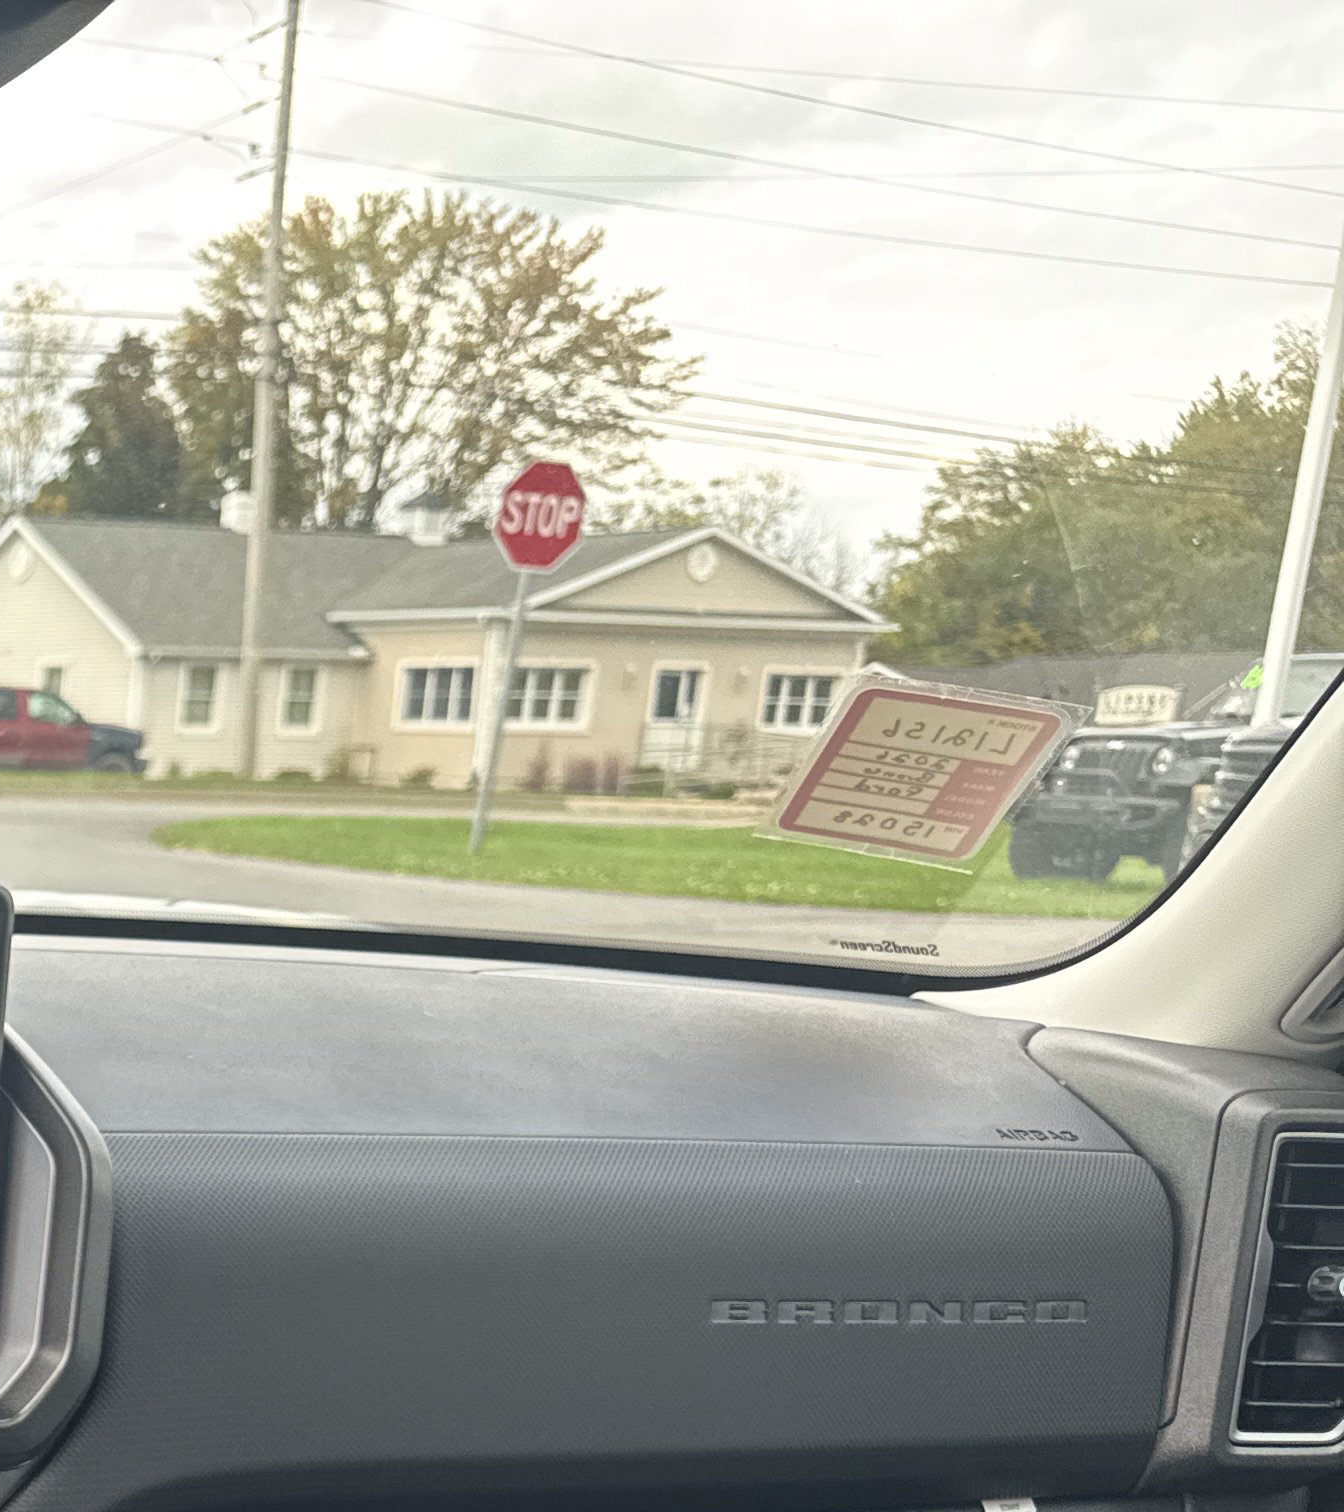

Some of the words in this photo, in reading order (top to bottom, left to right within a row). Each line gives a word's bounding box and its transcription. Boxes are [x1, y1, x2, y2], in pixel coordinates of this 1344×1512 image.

[500, 490, 582, 539] STOP
[995, 1129, 1080, 1141] AIRBAG
[711, 1300, 1087, 1324] BRONCO
